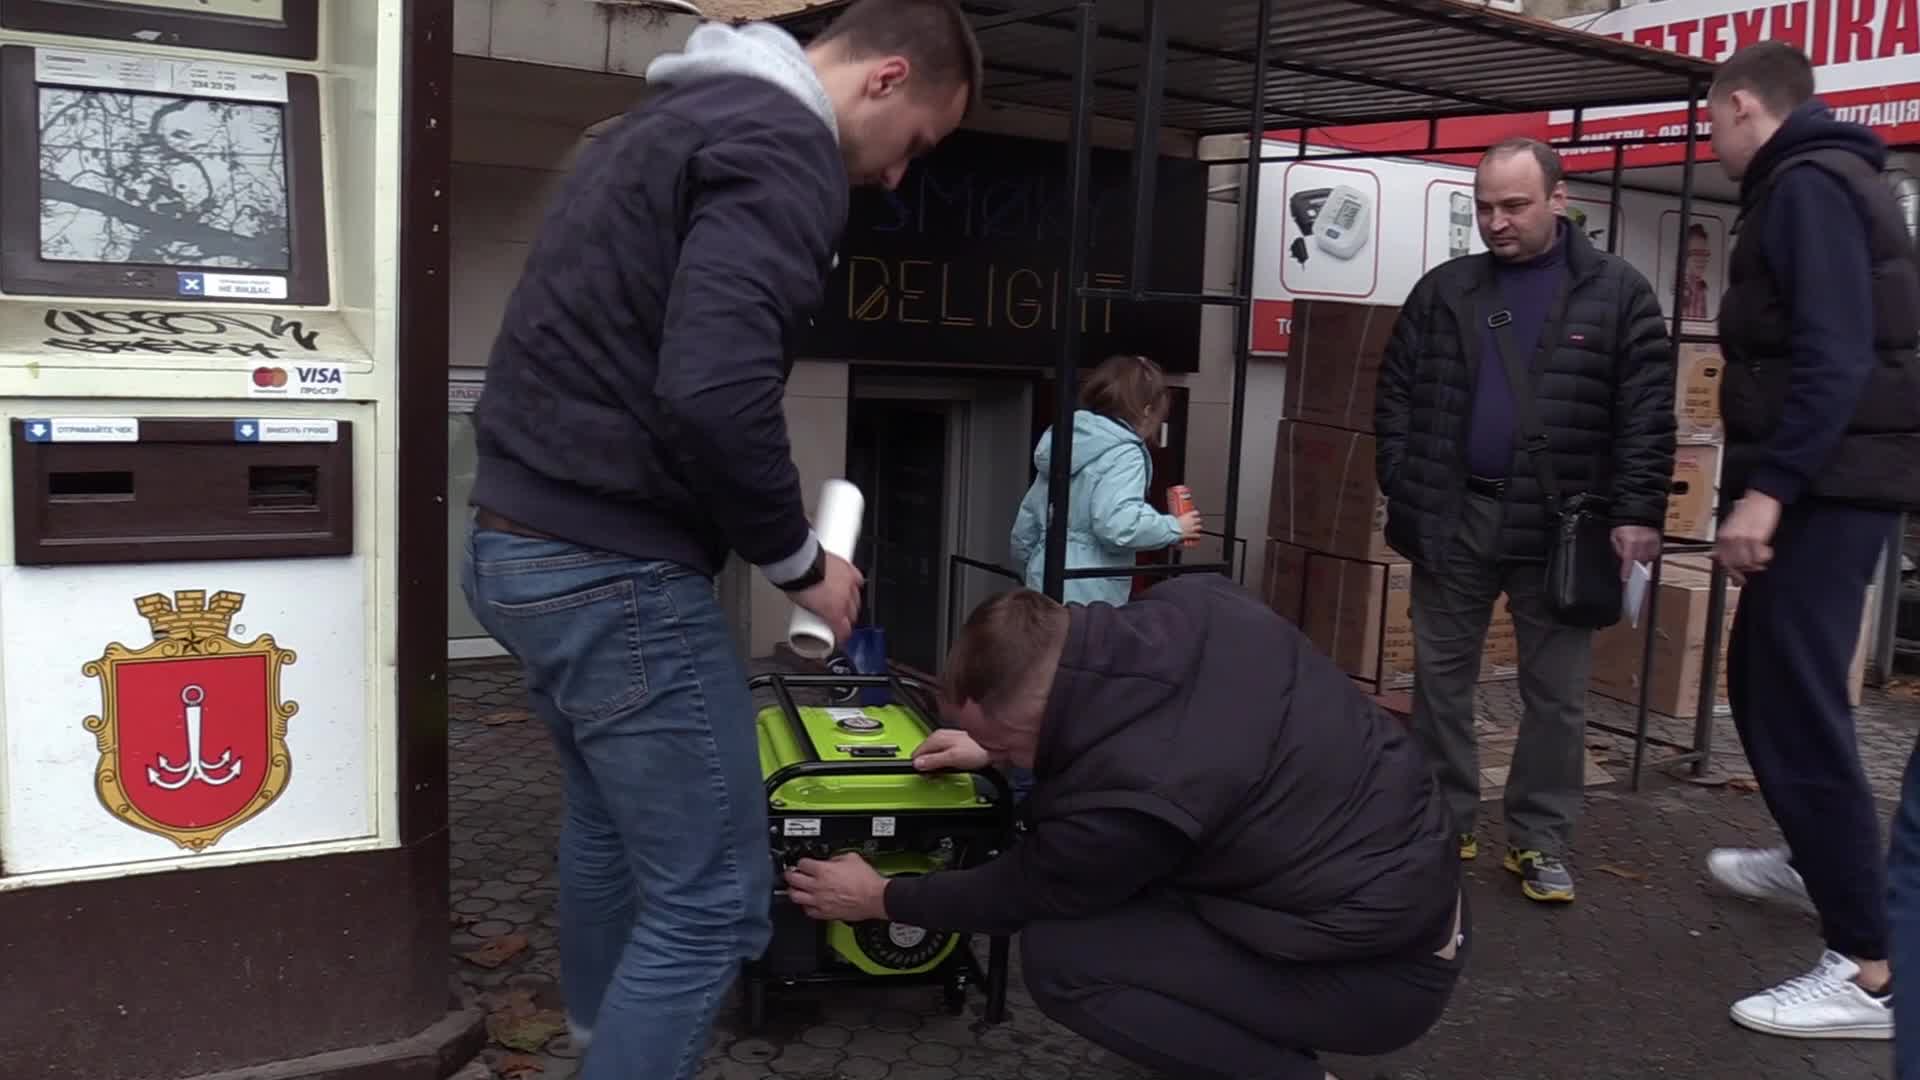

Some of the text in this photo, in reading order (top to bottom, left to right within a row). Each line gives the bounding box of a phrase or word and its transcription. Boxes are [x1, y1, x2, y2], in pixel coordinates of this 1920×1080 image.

[1601, 0, 1920, 66] ТЕХНІКА
[848, 255, 1127, 333] DELIGHT
[296, 366, 342, 384] VISA
